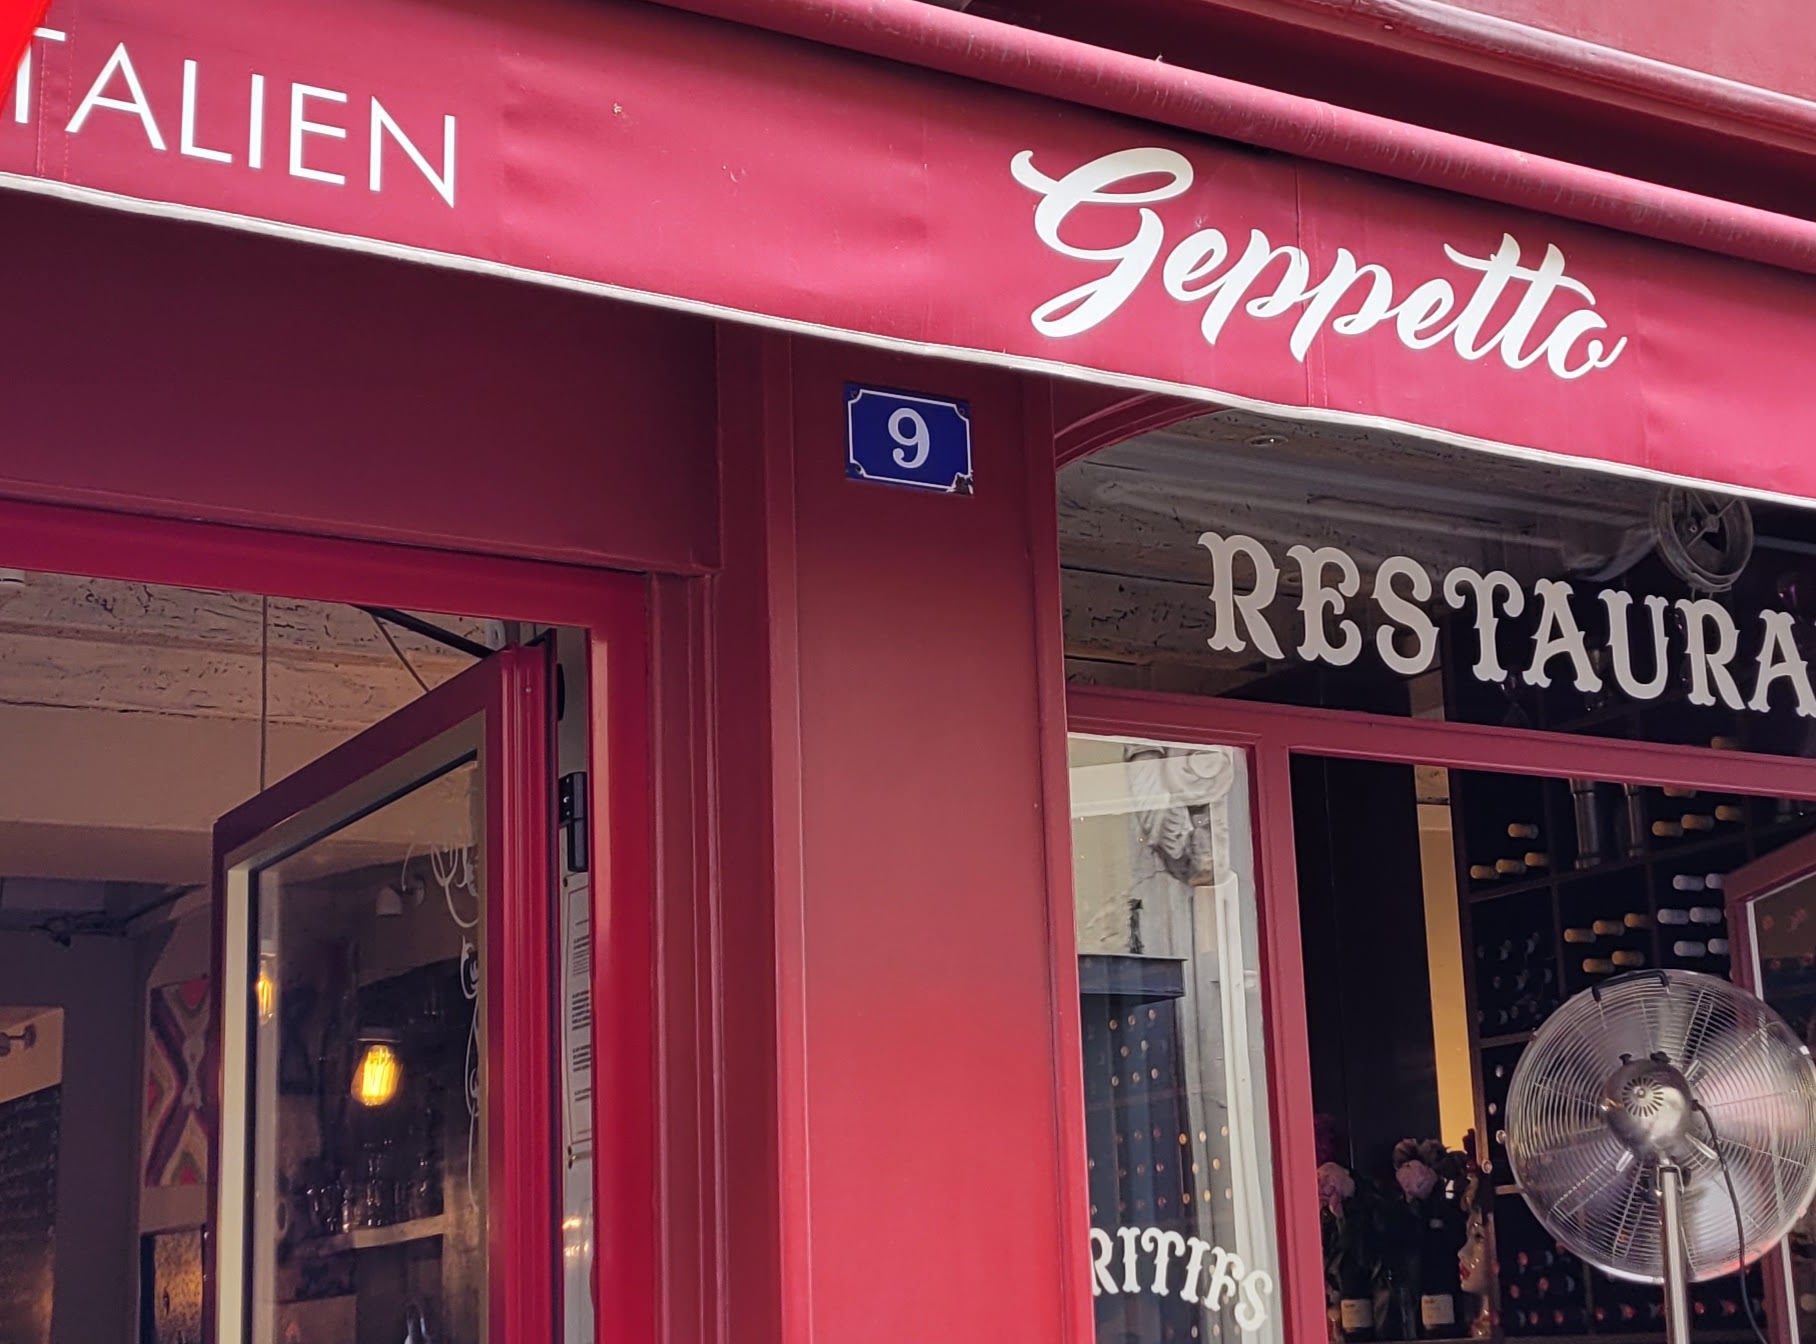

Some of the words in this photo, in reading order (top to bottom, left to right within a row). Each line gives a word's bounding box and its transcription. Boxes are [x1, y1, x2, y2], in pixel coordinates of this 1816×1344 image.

[1010, 147, 1628, 380] Geppetto
[887, 407, 931, 469] 9
[1198, 531, 1816, 719] RESTAURA
